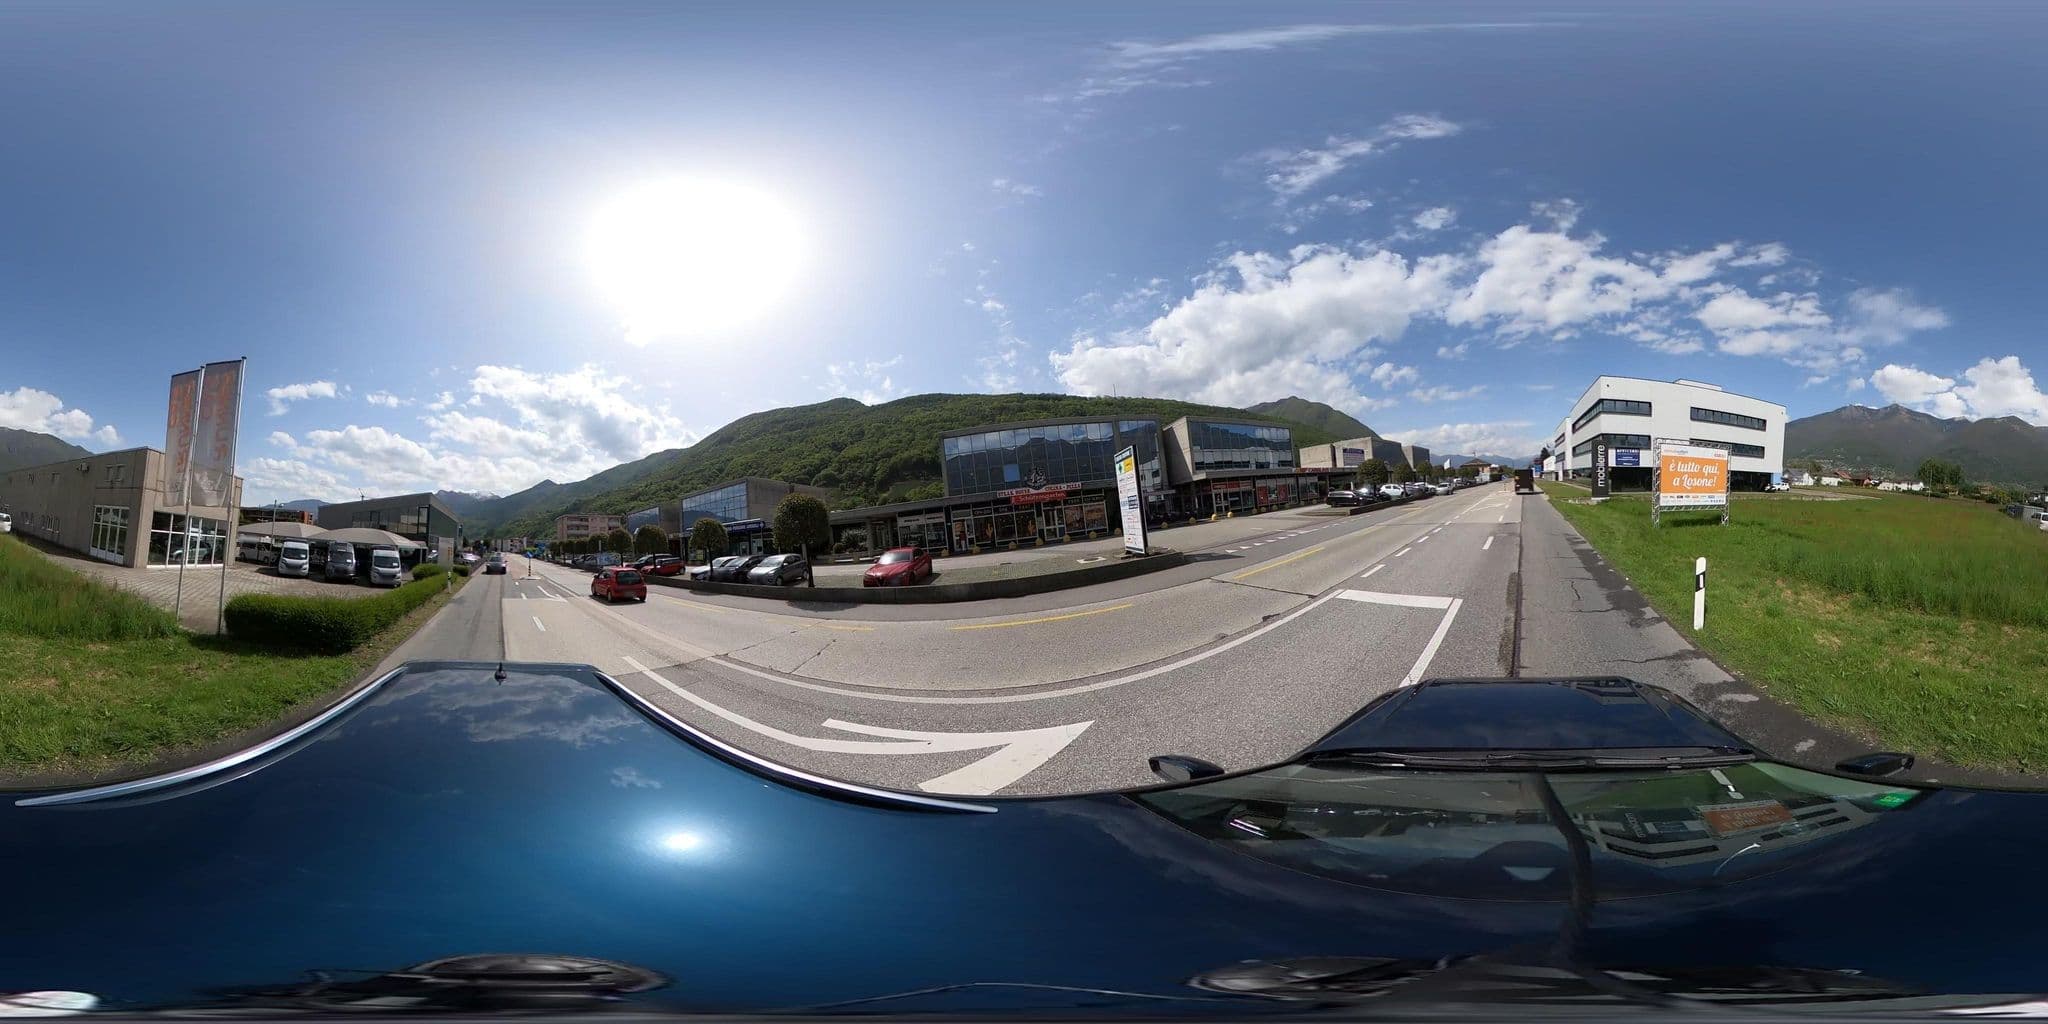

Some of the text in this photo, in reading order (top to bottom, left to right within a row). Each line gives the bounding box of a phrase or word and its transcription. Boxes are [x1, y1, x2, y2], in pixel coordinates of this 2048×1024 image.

[1669, 459, 1676, 472] è
[1677, 461, 1700, 473] tutto
[1672, 474, 1717, 489] a Losone!
